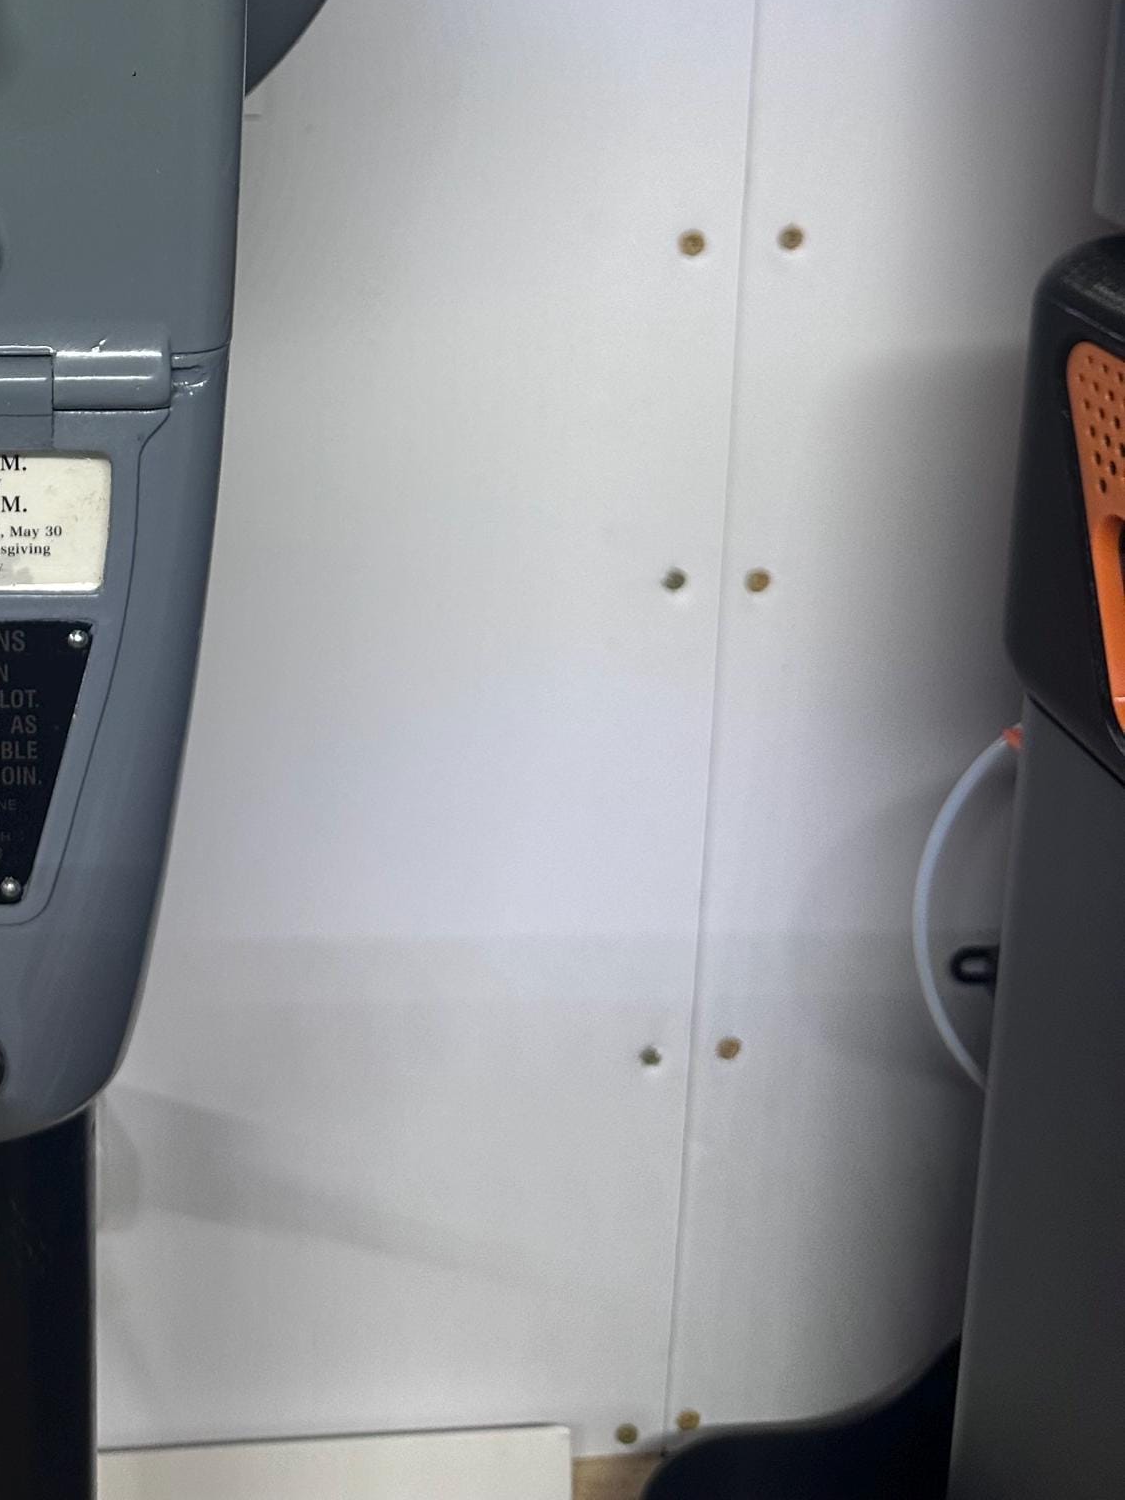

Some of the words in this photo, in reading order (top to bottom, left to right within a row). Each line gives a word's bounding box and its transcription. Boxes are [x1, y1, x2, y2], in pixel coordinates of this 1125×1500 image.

[10, 526, 39, 539] May
[45, 525, 62, 537] 30
[11, 715, 37, 734] AS
